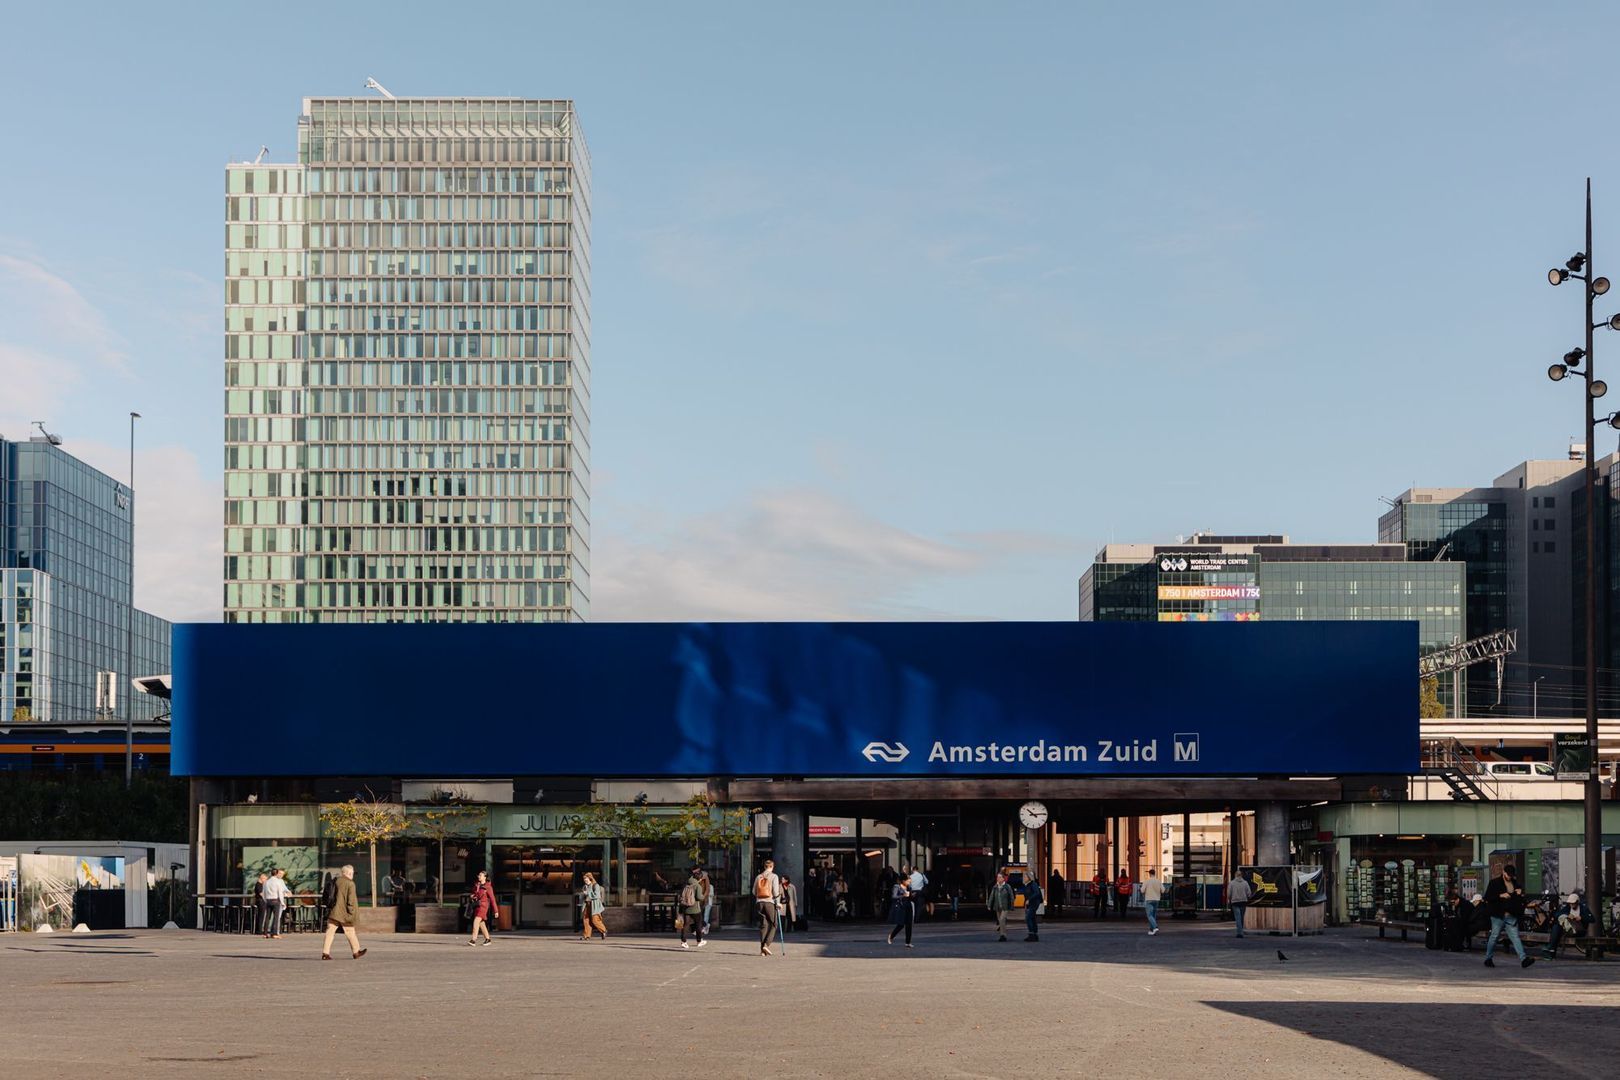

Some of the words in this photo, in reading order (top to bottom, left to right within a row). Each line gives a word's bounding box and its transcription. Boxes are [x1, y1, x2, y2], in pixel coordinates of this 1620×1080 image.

[1166, 589, 1180, 597] 750
[1188, 588, 1240, 598] AMSTERDAM
[928, 740, 1087, 763] Amsterdam
[1097, 739, 1158, 763] Zuid
[1174, 741, 1197, 761] M
